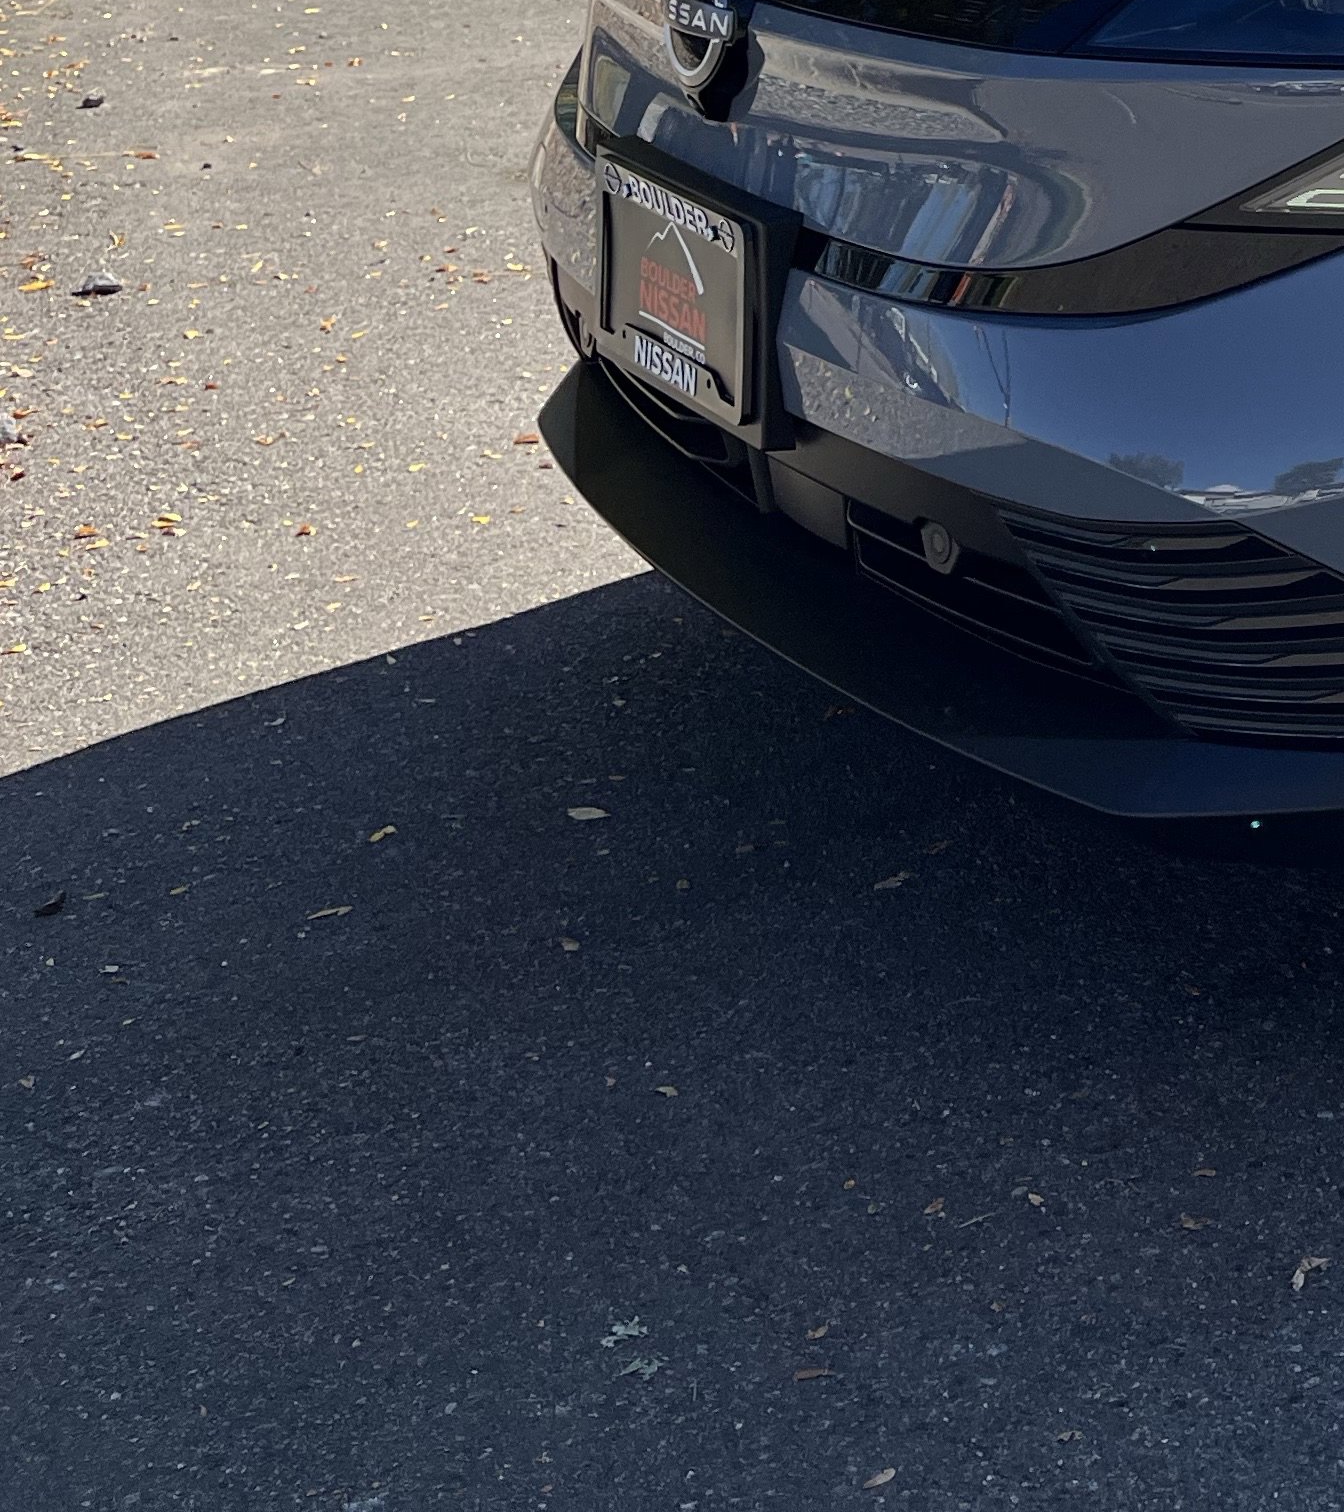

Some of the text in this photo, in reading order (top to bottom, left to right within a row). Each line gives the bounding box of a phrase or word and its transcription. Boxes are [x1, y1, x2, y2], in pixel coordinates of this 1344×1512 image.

[628, 174, 708, 236] BOULDER
[640, 256, 697, 303] BOULDER
[639, 279, 706, 343] NISSAN
[634, 335, 697, 398] NISSAN
